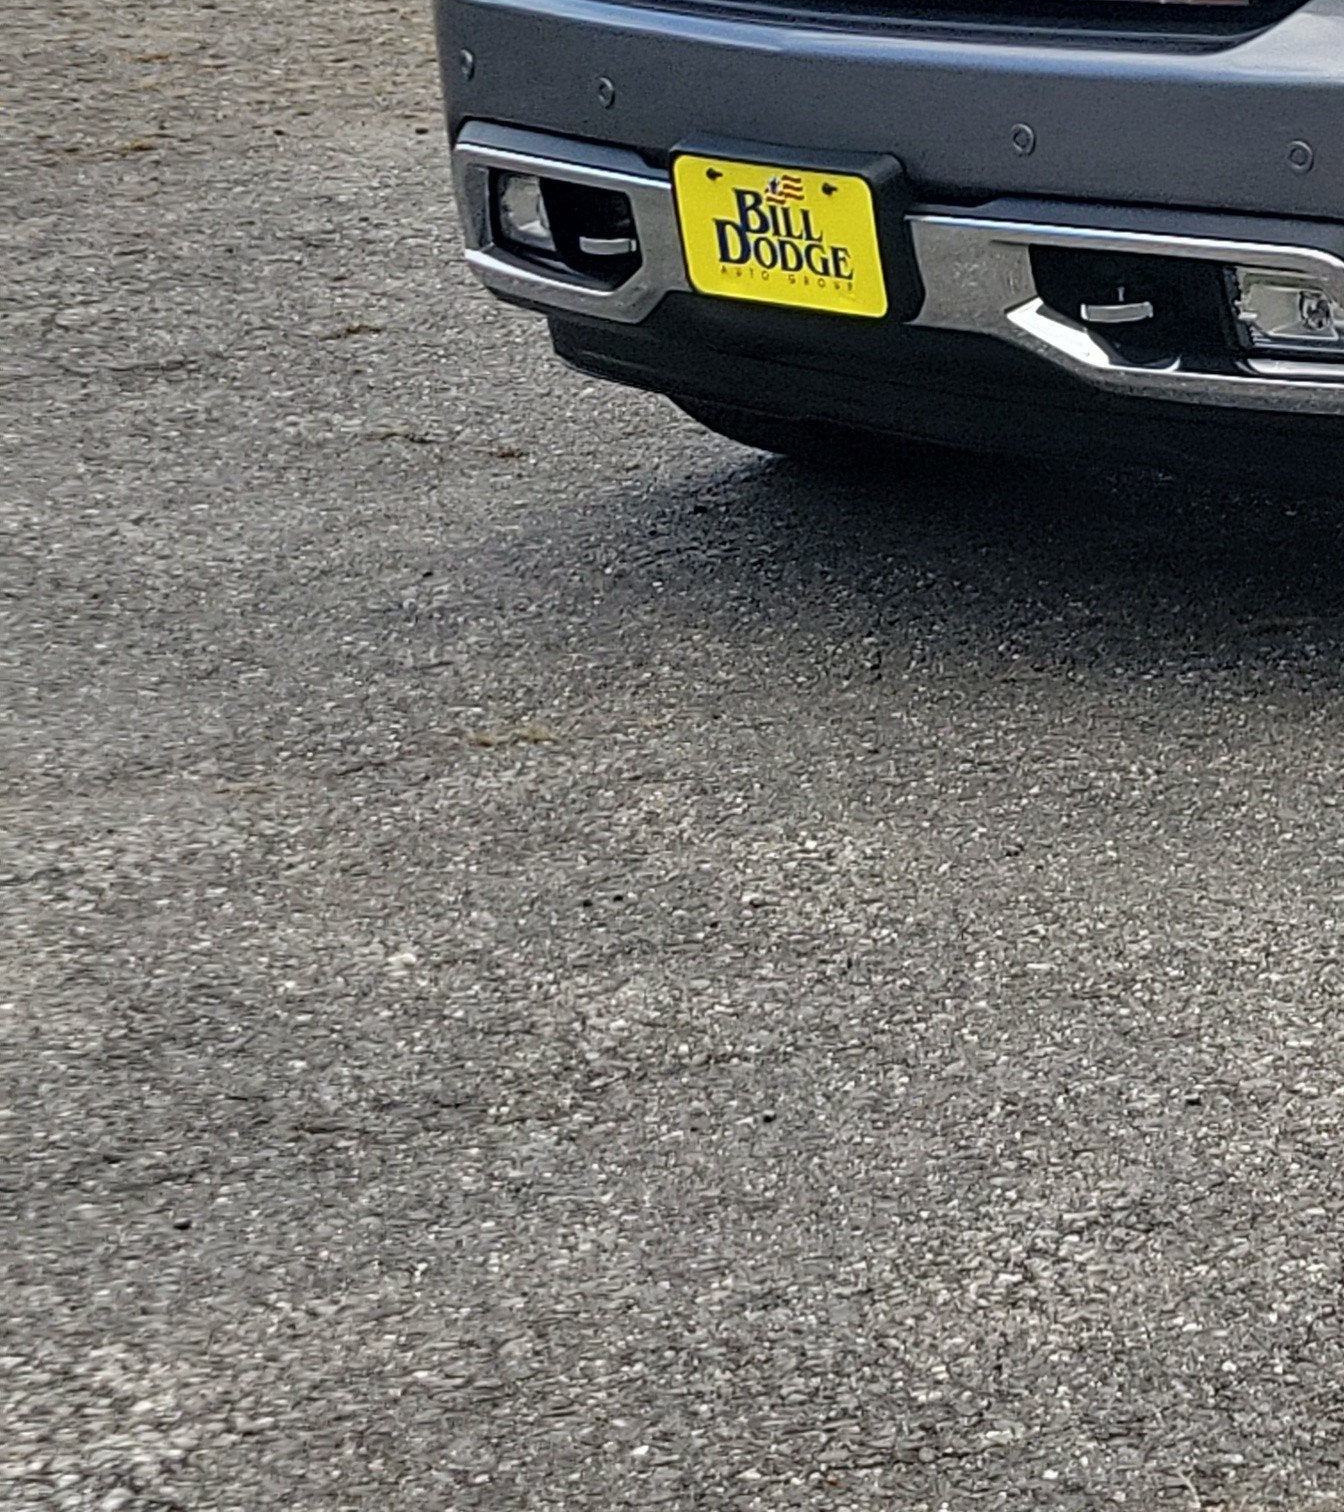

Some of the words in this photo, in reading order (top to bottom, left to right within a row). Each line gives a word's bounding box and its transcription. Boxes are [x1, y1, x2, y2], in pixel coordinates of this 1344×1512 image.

[733, 187, 823, 243] BILL
[713, 218, 854, 280] DODGE
[720, 265, 771, 281] AUTO
[788, 274, 855, 292] GROUP
